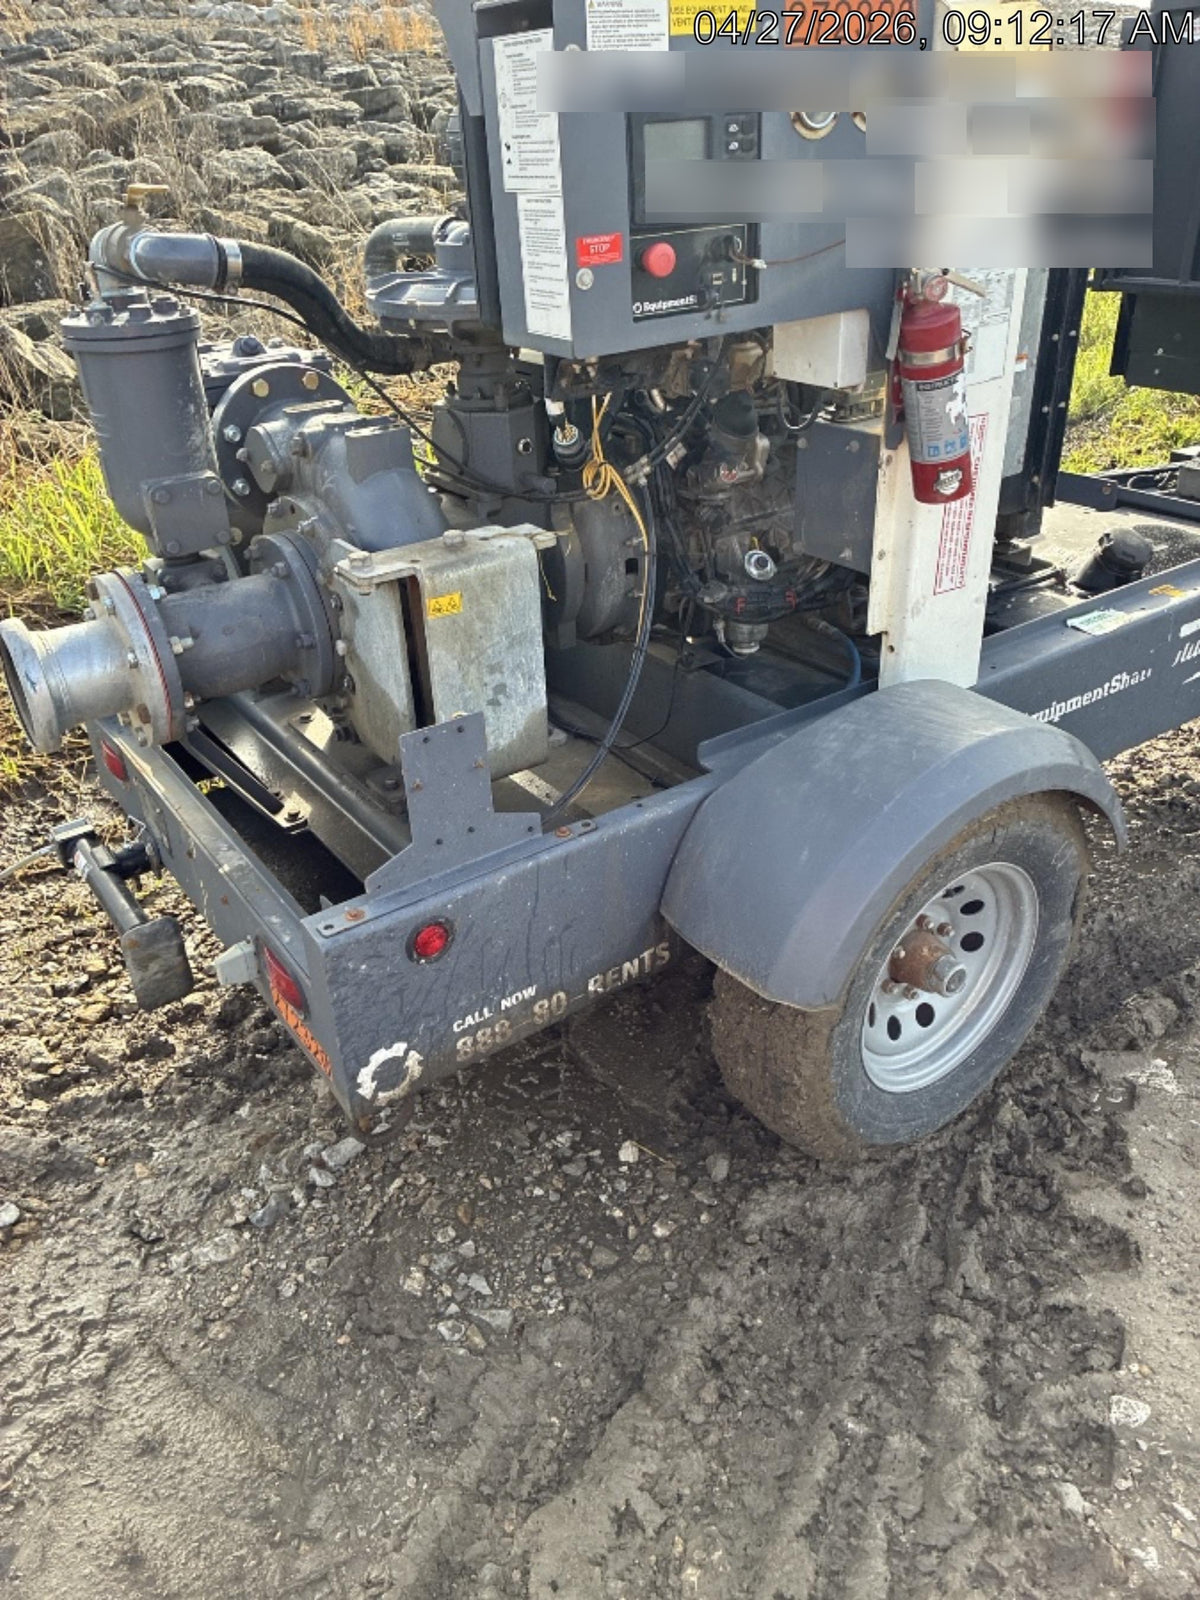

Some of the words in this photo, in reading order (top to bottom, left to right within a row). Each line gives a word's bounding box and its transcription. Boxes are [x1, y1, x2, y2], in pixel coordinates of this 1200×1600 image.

[589, 243, 611, 254] STOP
[643, 295, 697, 312] EquipmentS
[452, 1006, 494, 1033] CALL
[500, 984, 538, 1011] NOW
